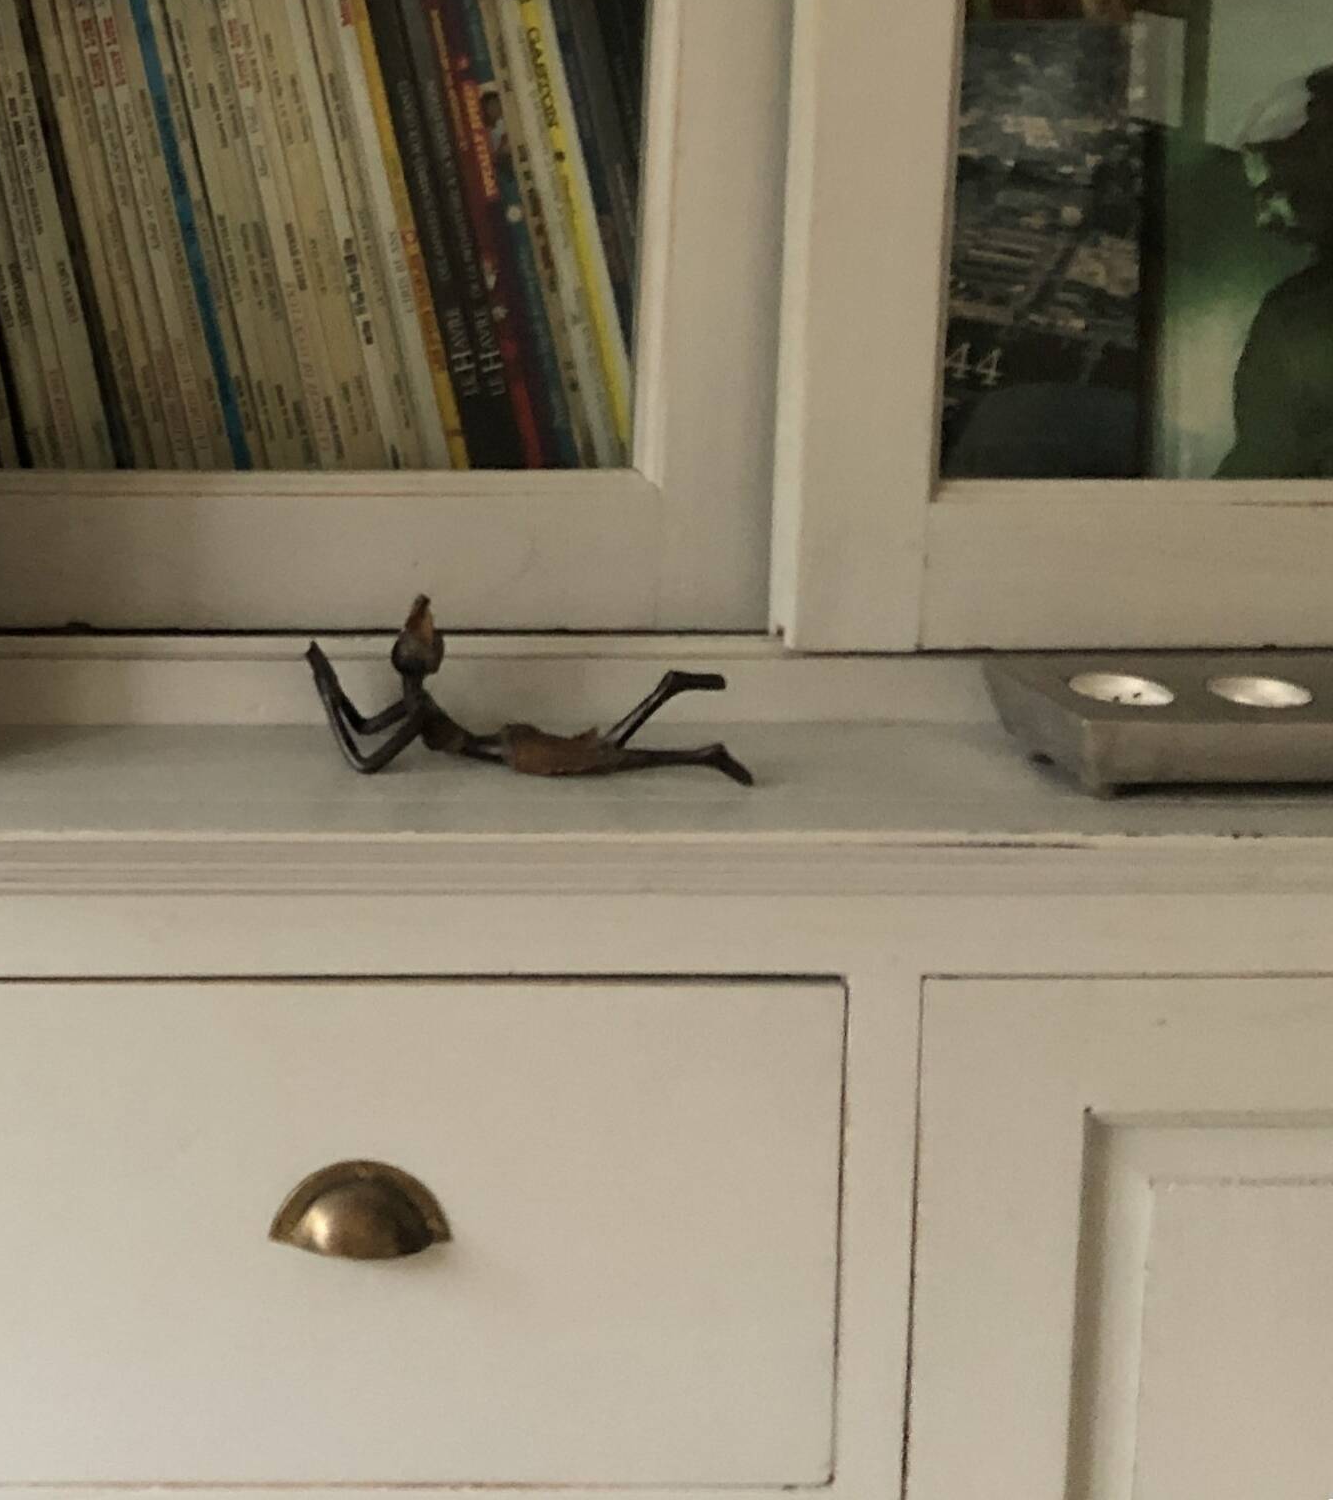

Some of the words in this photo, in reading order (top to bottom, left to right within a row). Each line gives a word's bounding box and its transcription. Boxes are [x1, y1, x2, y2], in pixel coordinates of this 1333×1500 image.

[78, 16, 97, 48] LUKE
[99, 15, 118, 47] LUKE
[223, 17, 242, 50] LUKE
[85, 51, 106, 90] LUCKY
[106, 48, 127, 87] LUCKY
[230, 50, 251, 89] LUCKY
[523, 24, 561, 129] GASTON
[55, 258, 71, 288] LUKE
[61, 287, 79, 325] LUCKY
[439, 304, 477, 374] HAVRE
[467, 304, 504, 375] HAVRE
[486, 373, 507, 398] LE
